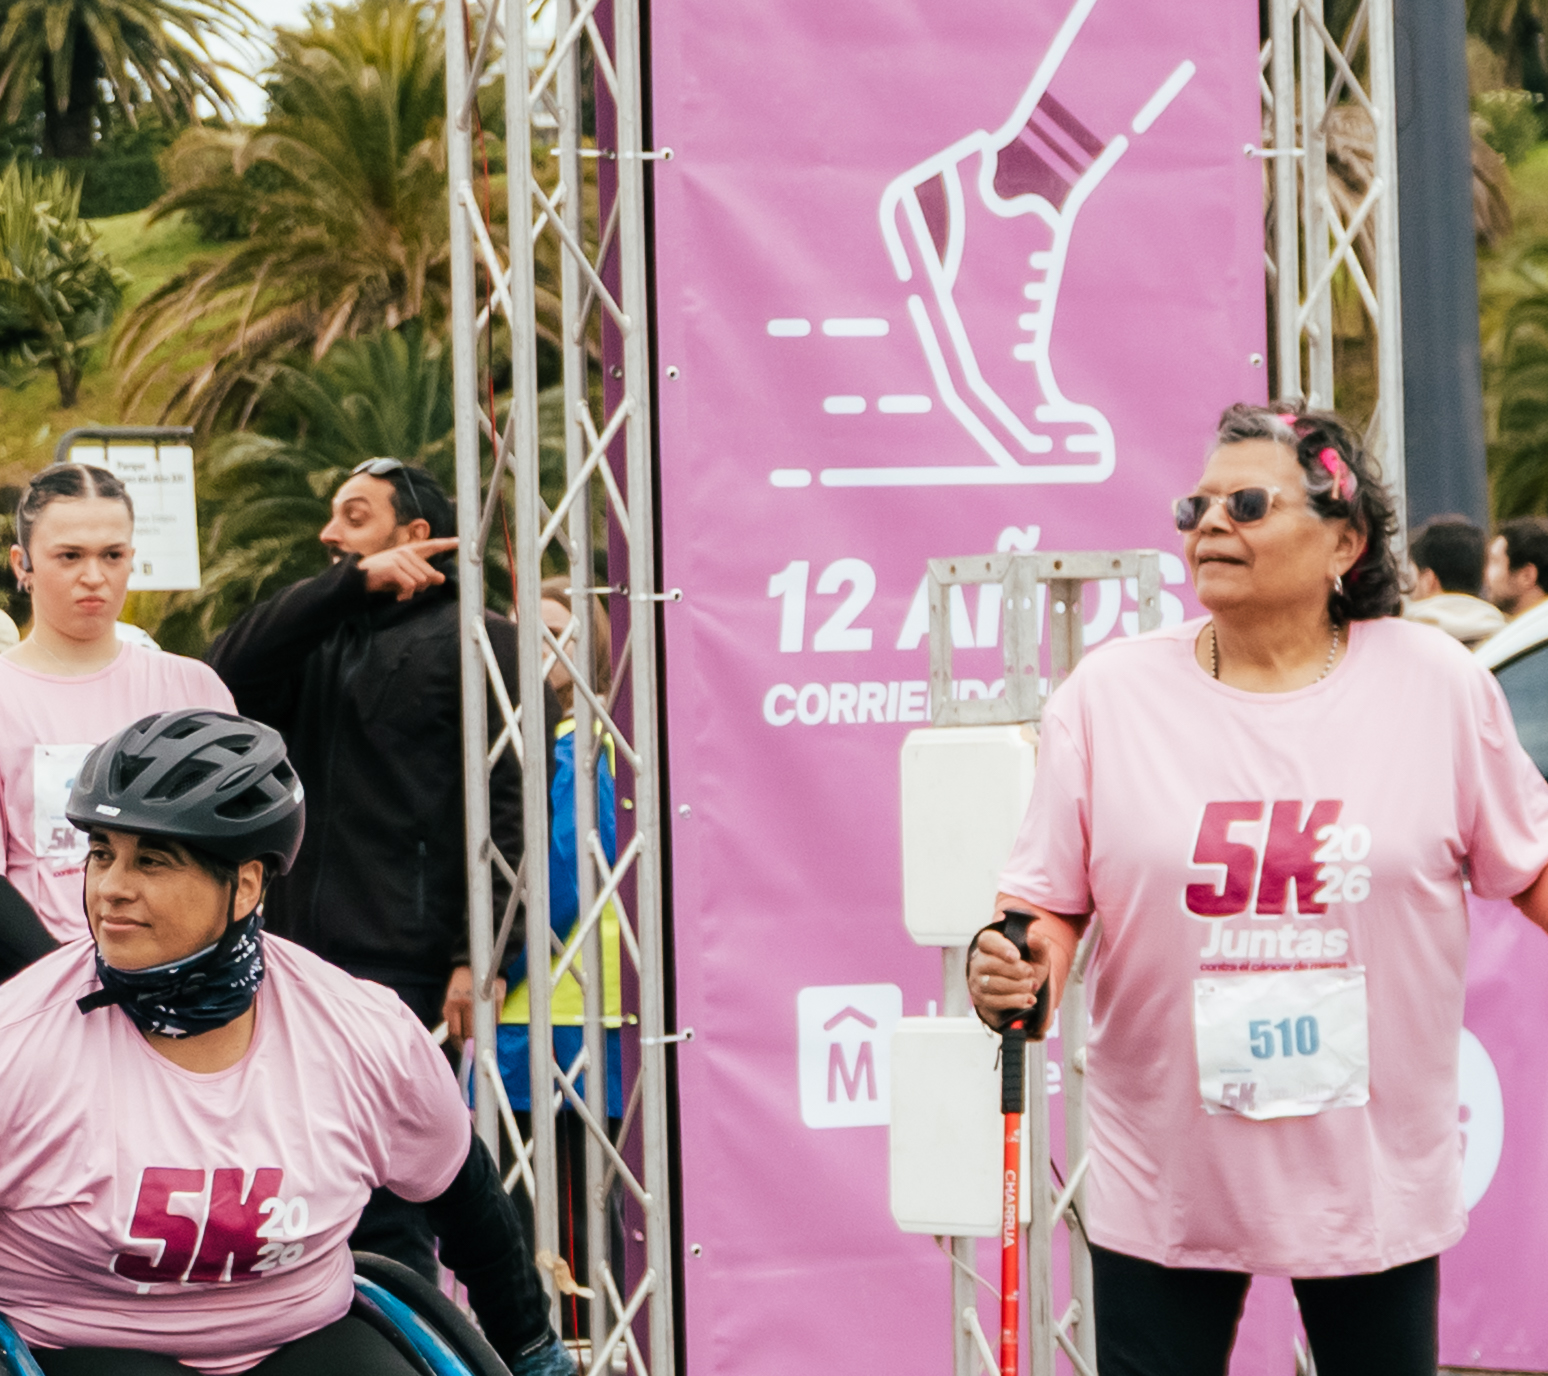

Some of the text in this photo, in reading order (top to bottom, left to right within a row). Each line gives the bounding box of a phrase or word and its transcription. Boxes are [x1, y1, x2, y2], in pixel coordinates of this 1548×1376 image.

[768, 558, 876, 653] 12
[1181, 799, 1371, 921] 5K 20
[1313, 865, 1372, 904] 26
[1200, 921, 1348, 959] Juntas
[1249, 1015, 1320, 1060] 510
[109, 1167, 309, 1286] 5K 20
[1003, 1170, 1017, 1248] CHARRUA
